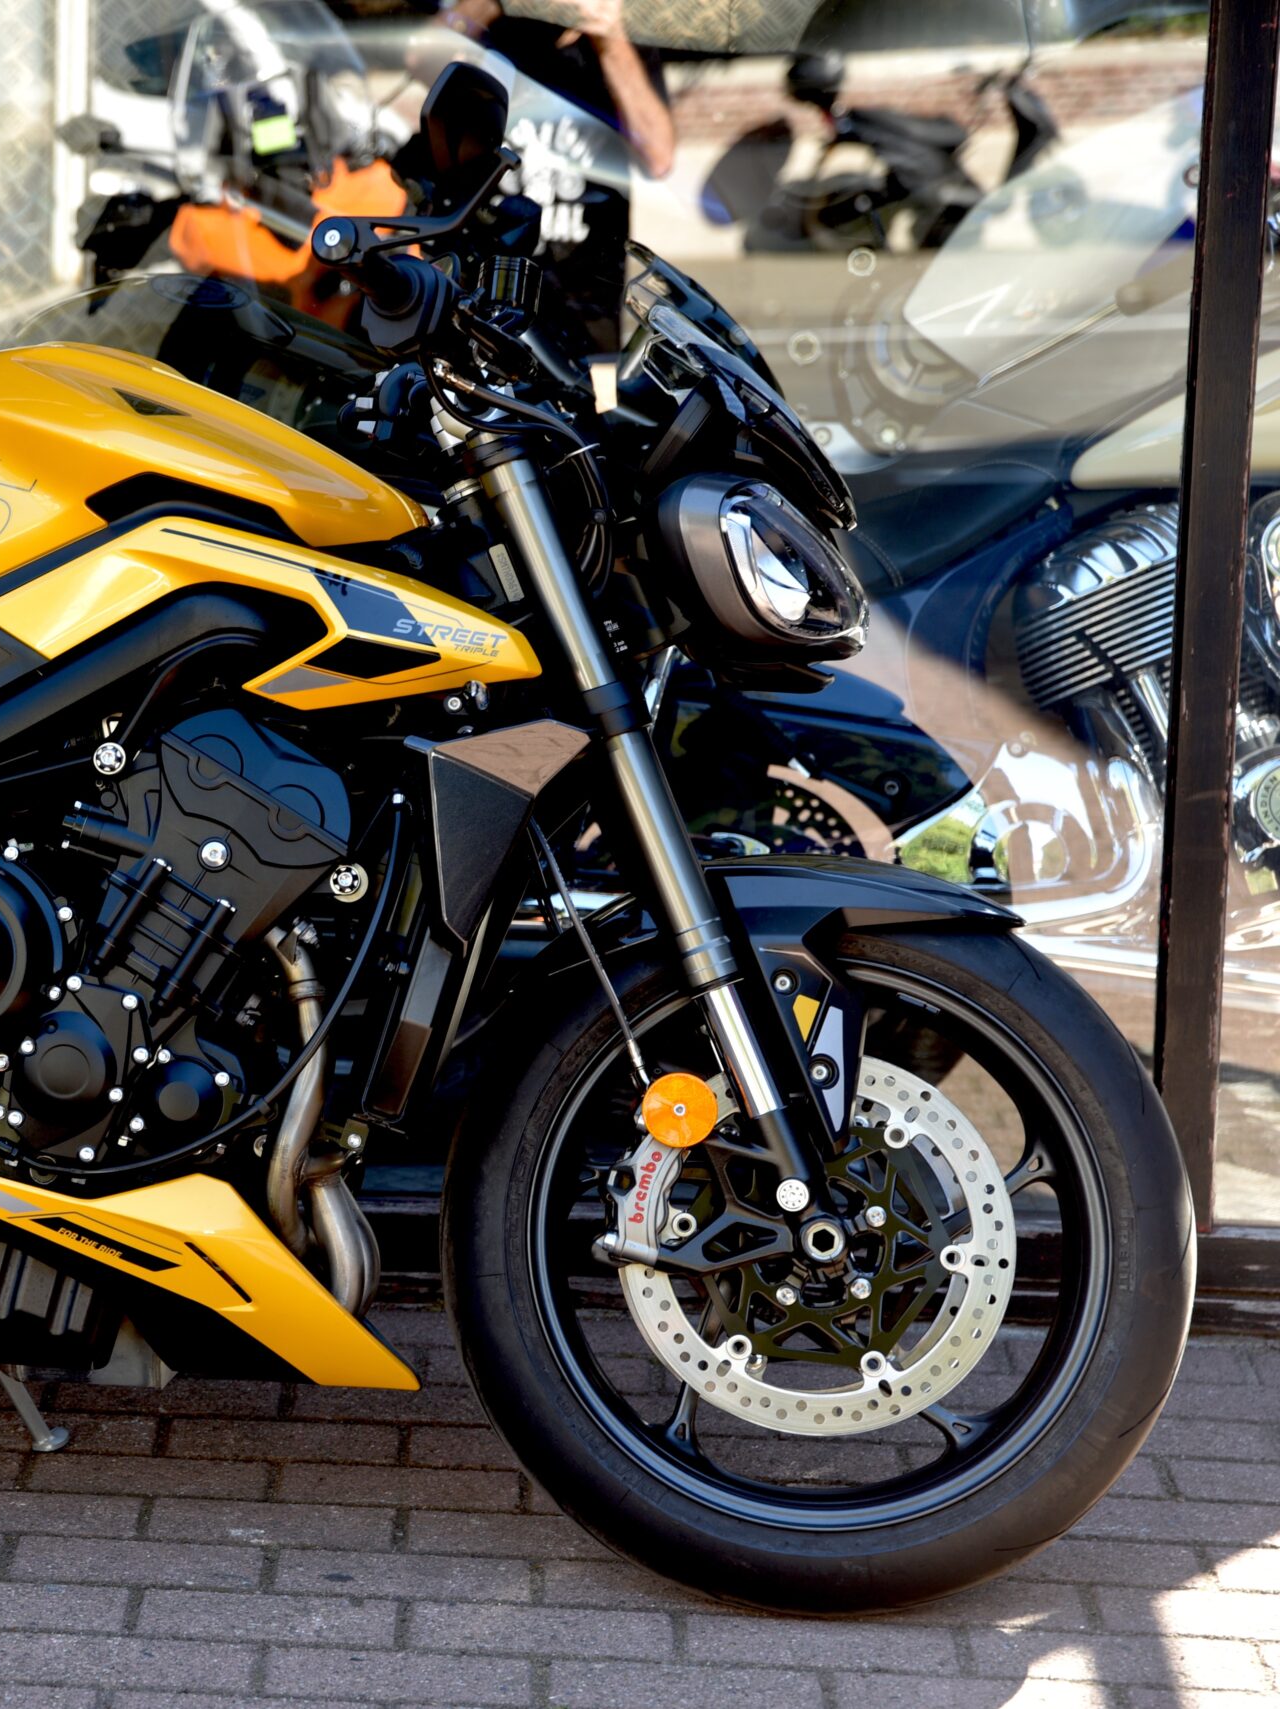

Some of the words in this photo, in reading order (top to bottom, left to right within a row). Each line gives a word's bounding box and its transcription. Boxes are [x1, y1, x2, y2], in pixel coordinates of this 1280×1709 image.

[392, 618, 508, 649] STREET
[453, 643, 500, 658] TRIPLE
[628, 1151, 662, 1224] brembo
[58, 1227, 79, 1240] FOR
[79, 1235, 99, 1247] THE
[99, 1244, 123, 1258] RIDE
